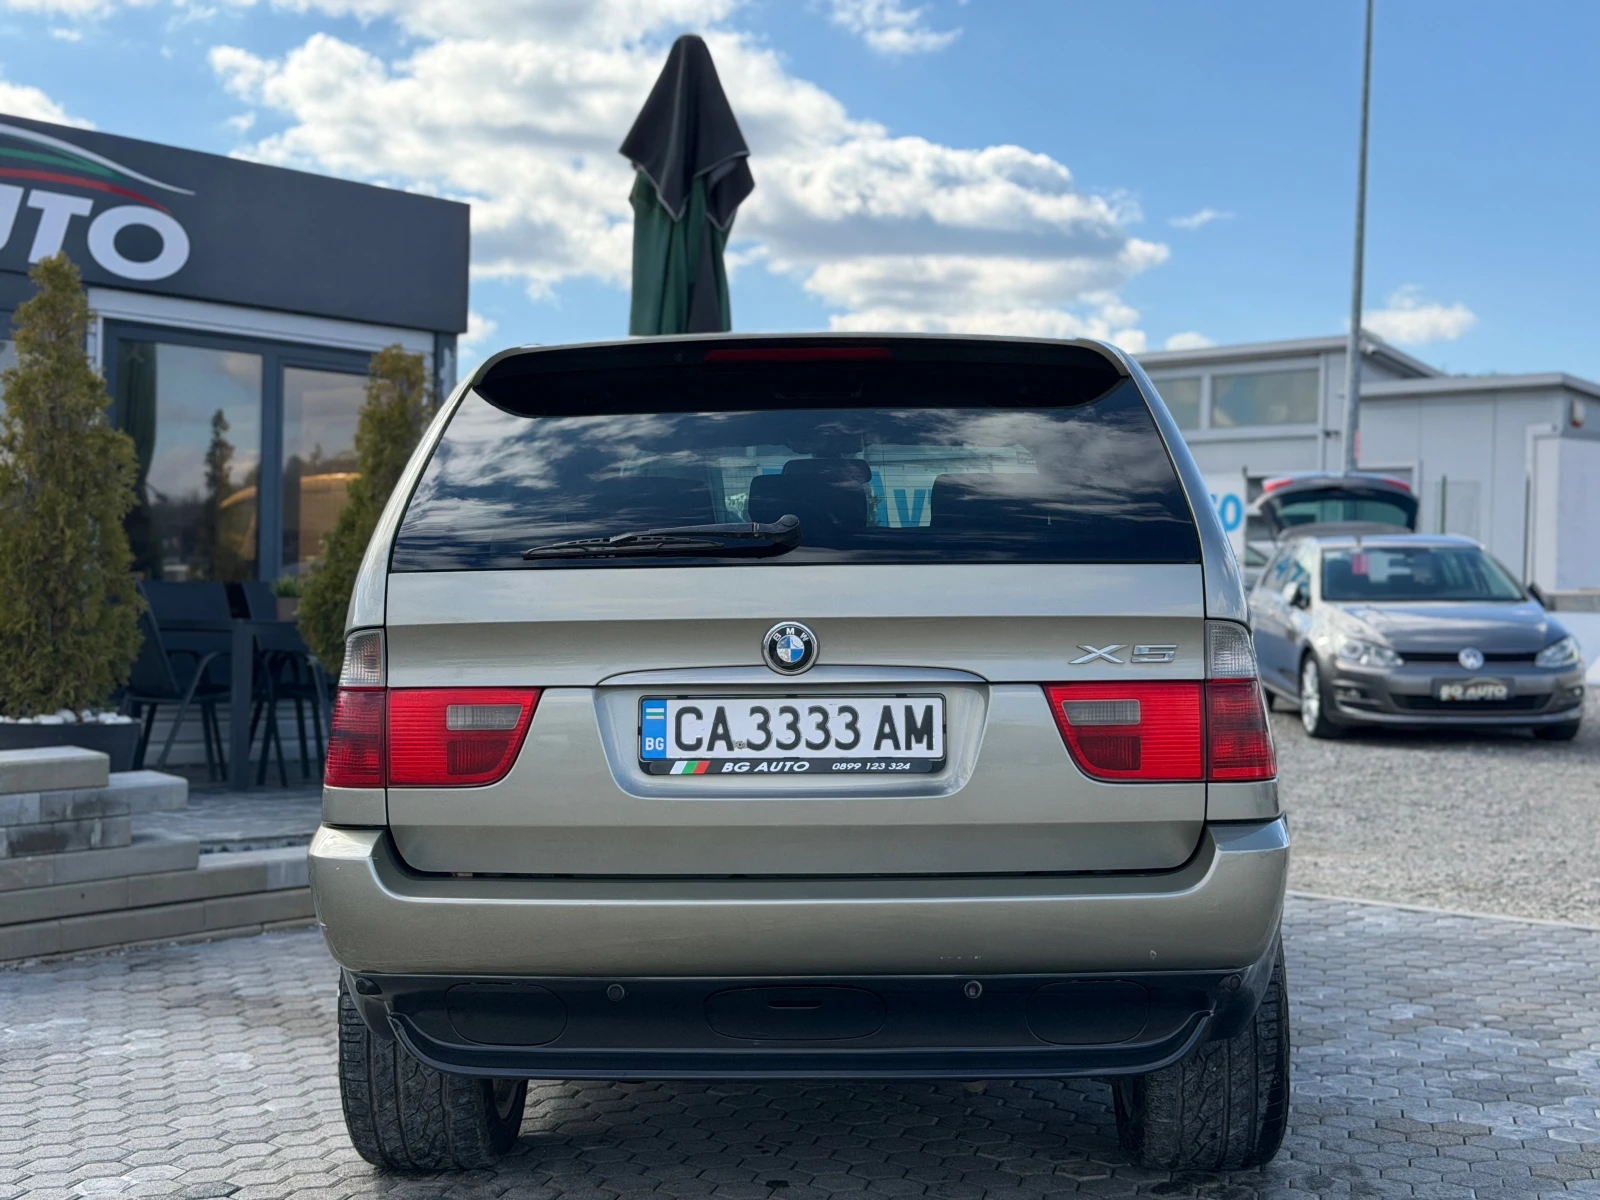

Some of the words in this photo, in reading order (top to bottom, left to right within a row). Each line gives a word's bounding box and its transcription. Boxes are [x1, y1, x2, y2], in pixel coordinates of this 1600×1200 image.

[772, 627, 810, 642] BMW
[1068, 644, 1178, 665] X5
[674, 705, 735, 752] CA
[746, 705, 862, 752] 3333
[873, 704, 934, 751] AM
[645, 737, 665, 751] BG
[721, 762, 752, 773] BG
[753, 761, 810, 773] AUTO
[831, 762, 862, 771] 0899
[865, 762, 886, 771] 123
[888, 762, 911, 771] 324
